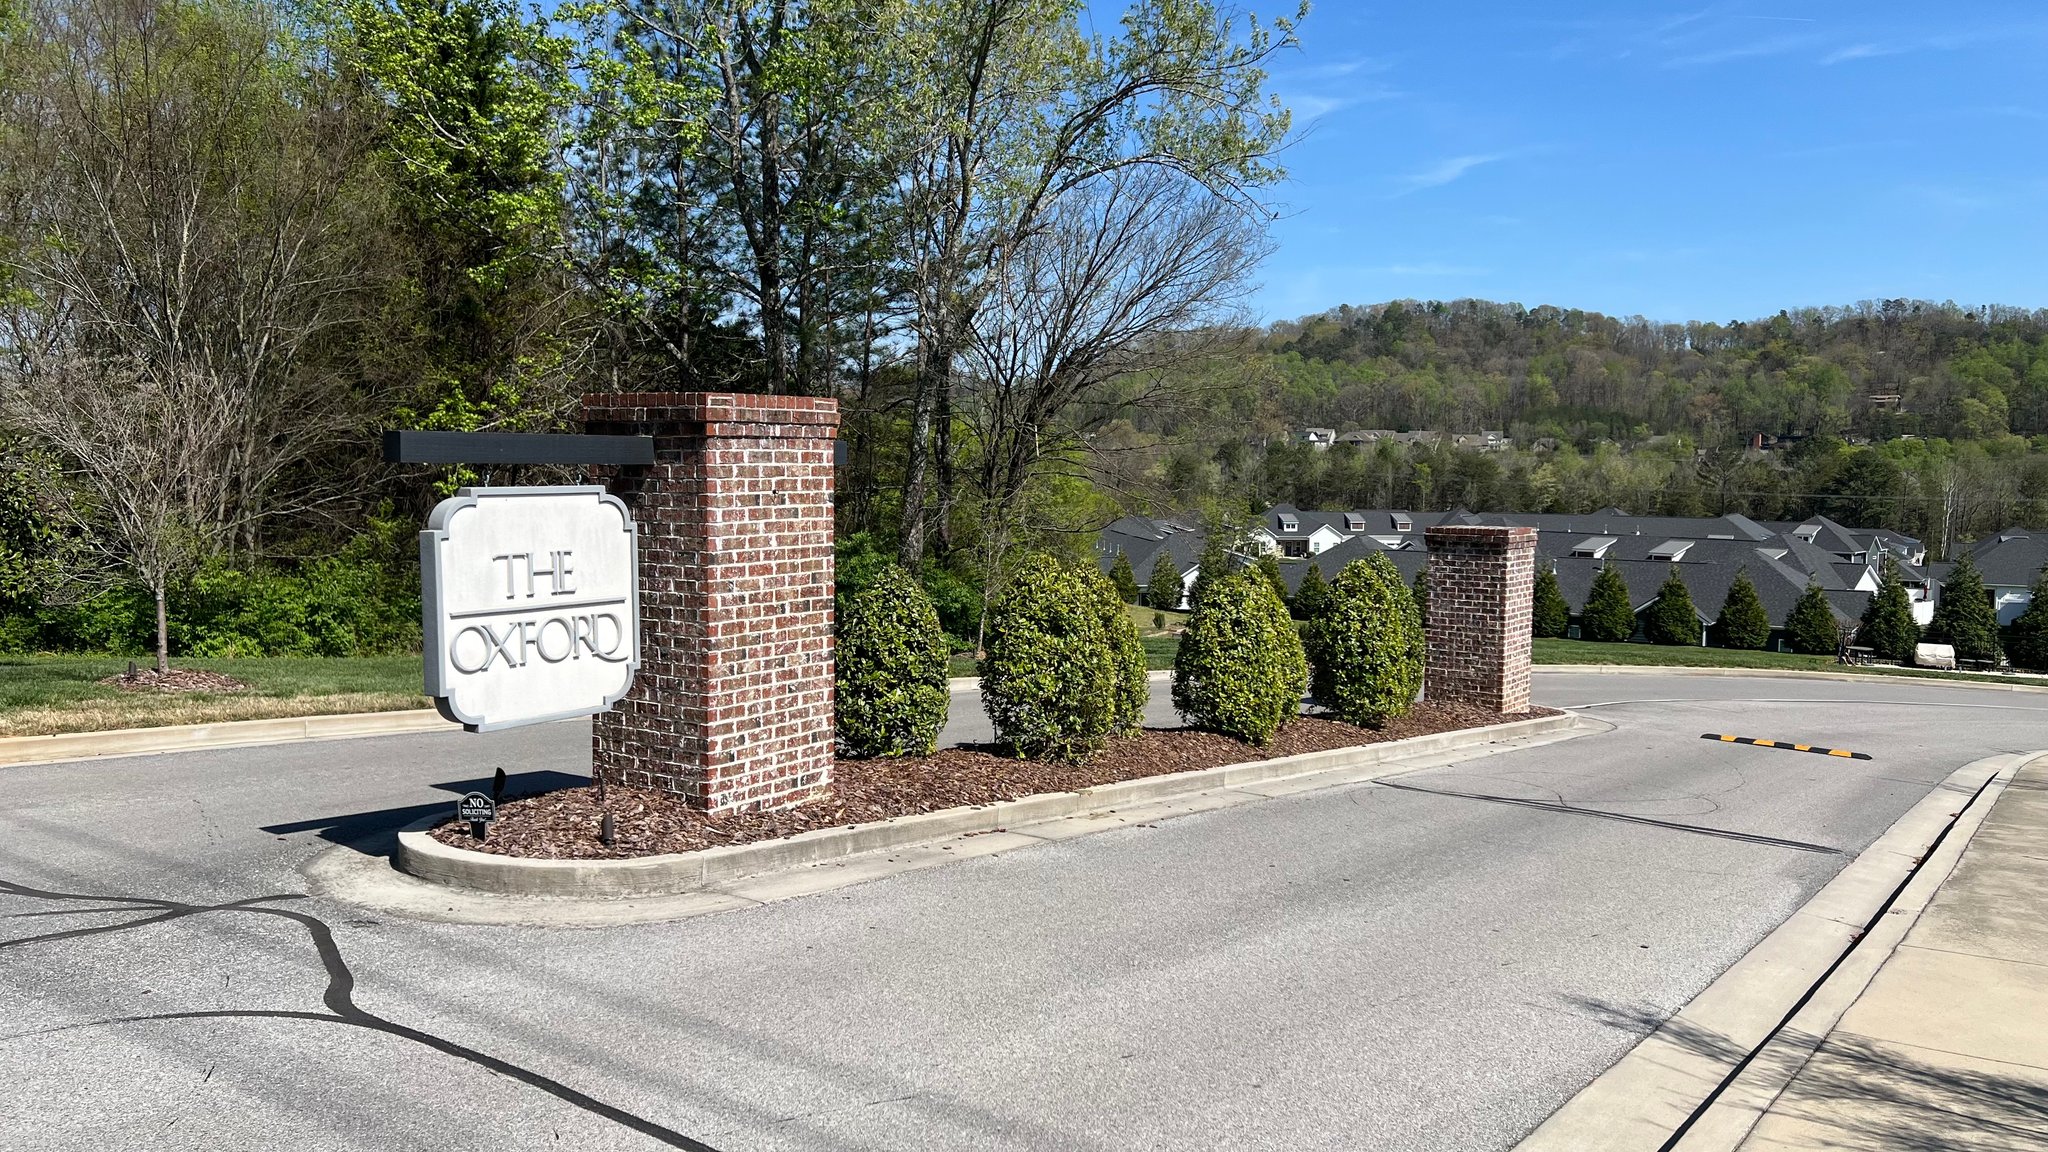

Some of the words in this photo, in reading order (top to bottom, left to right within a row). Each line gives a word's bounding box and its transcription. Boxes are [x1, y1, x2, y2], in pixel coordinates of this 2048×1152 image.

[492, 550, 577, 599] THE
[450, 613, 628, 674] OXFORD
[469, 798, 484, 807] NO
